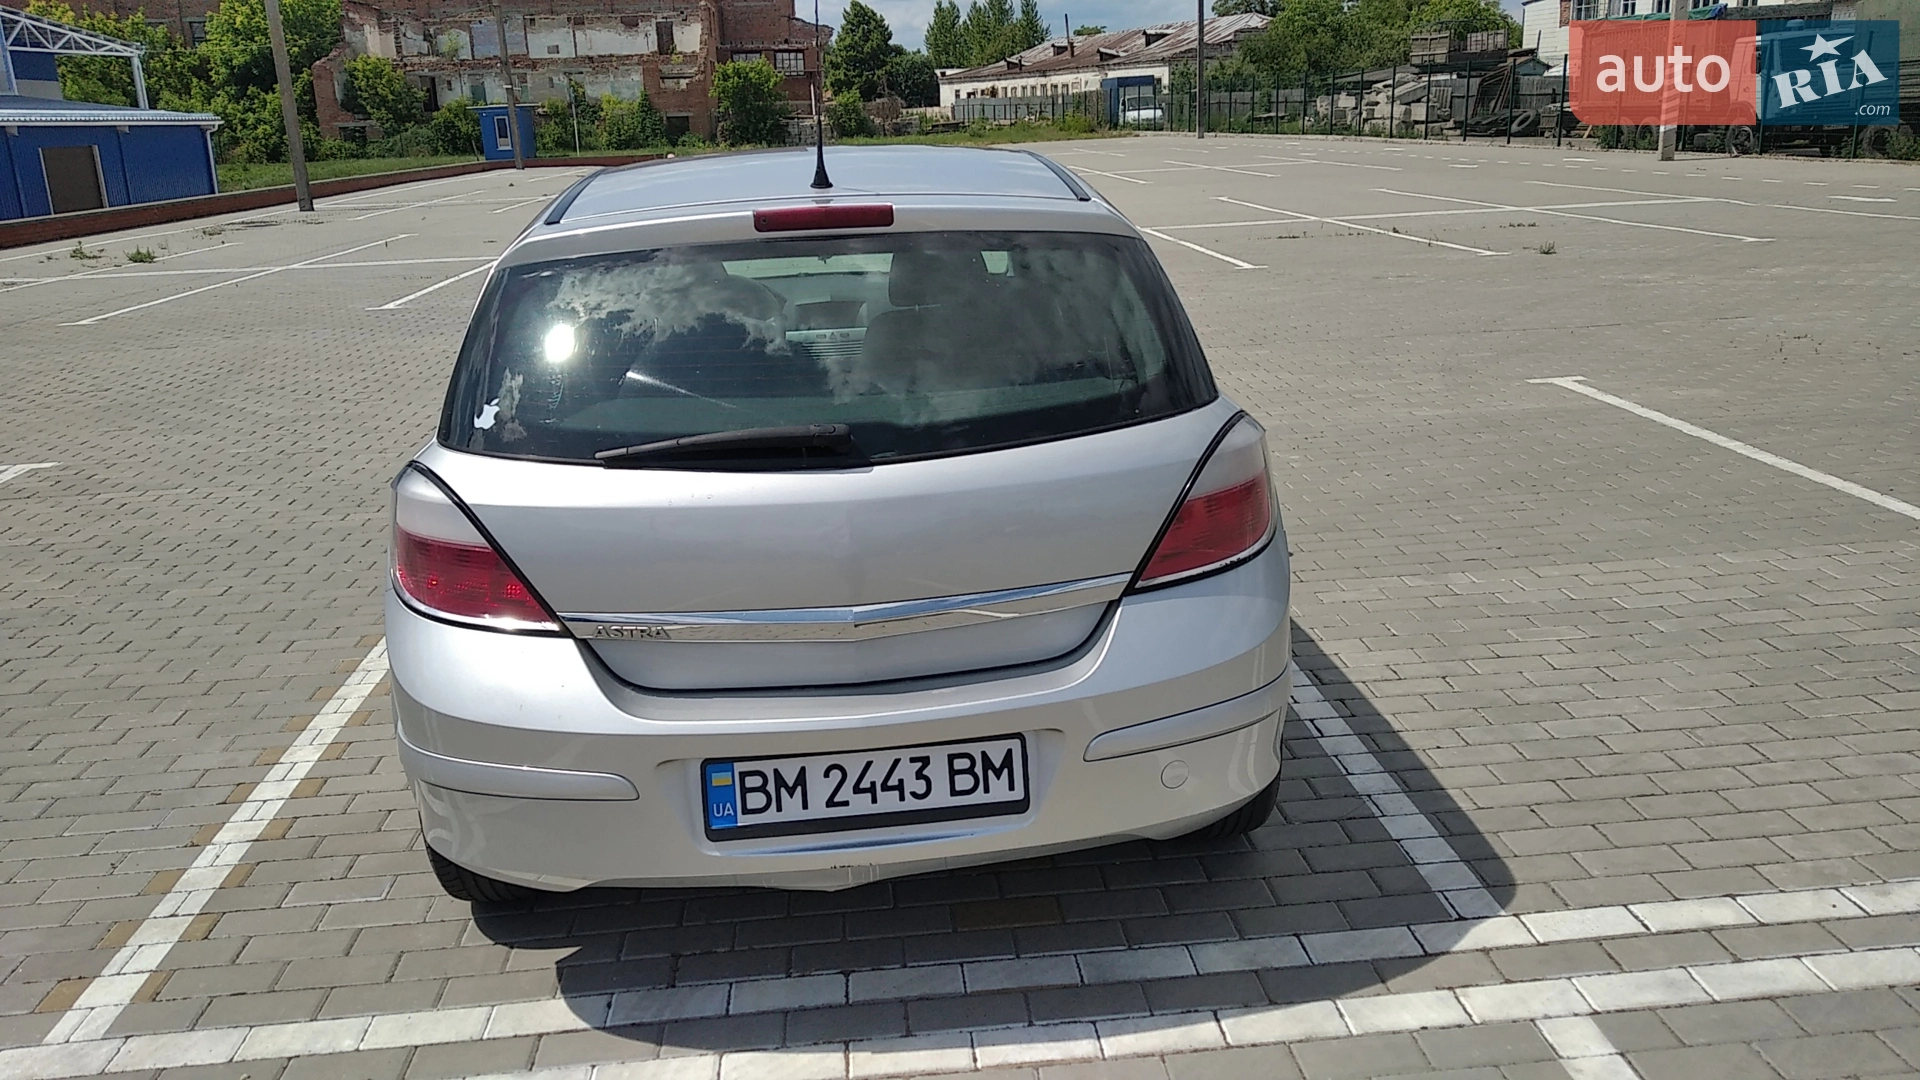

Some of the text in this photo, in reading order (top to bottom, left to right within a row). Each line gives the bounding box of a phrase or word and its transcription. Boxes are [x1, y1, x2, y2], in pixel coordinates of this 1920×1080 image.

[593, 624, 672, 640] ASTRA
[738, 748, 1016, 815] BM 2443 BM
[713, 802, 735, 818] UA
